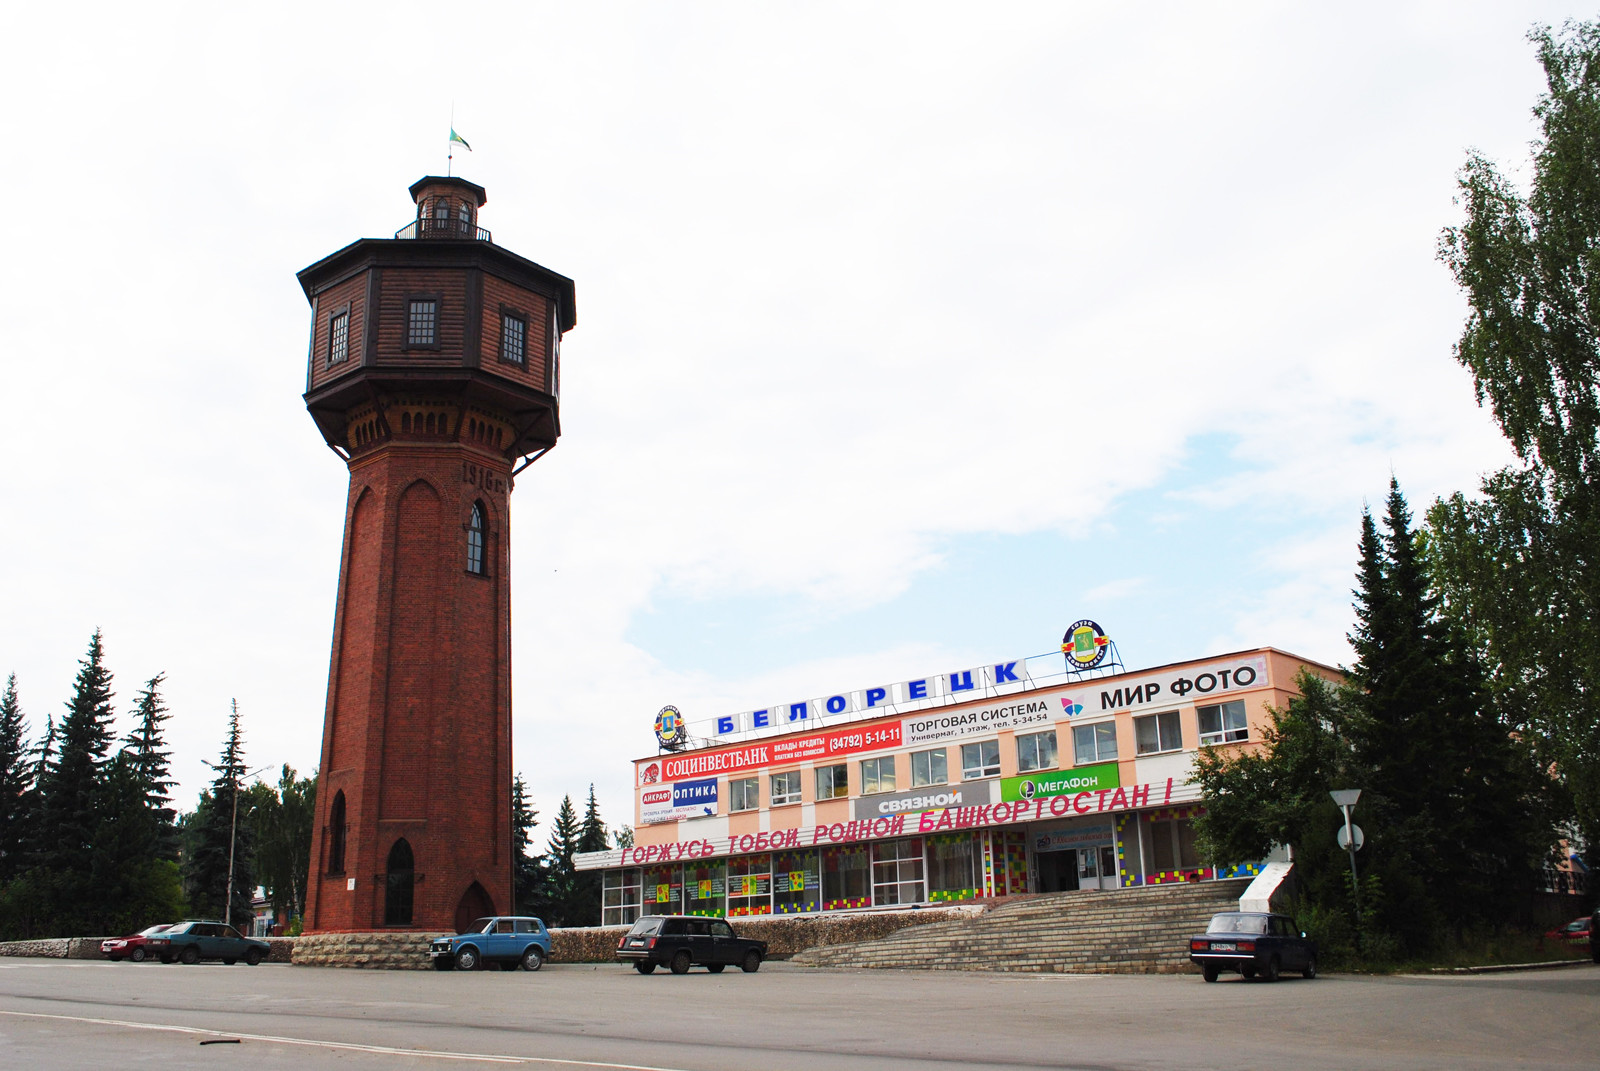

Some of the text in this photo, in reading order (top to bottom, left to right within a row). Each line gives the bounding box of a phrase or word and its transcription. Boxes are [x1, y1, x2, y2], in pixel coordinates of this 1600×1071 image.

[718, 661, 1018, 734] БЕЛОРЕЦК
[1101, 666, 1256, 709] МИР ФОТО
[910, 701, 1048, 733] ТОРГОВАЯ СИСТЕМА
[911, 731, 957, 742] Универмаг,
[967, 724, 990, 733] этаж,
[993, 720, 1010, 729] тел.
[1013, 713, 1047, 725] 5-34-54
[774, 737, 824, 752] ВКЛАДЫ КРЕДИТЫ
[829, 728, 900, 752] (34792) 5-14-11
[666, 747, 769, 777] СОЦИНВЕСТБАНК
[643, 790, 671, 802] АЙКРАФТ
[674, 785, 717, 799] ОПТИКА
[879, 789, 962, 813] СВЯЗНОЙ
[621, 838, 714, 865] ГОРЖУСЬ
[728, 828, 800, 854] ТОБОЙ,
[813, 815, 904, 844] РОДНОЙ
[919, 784, 1149, 832] БАШКОРТОСТАН
